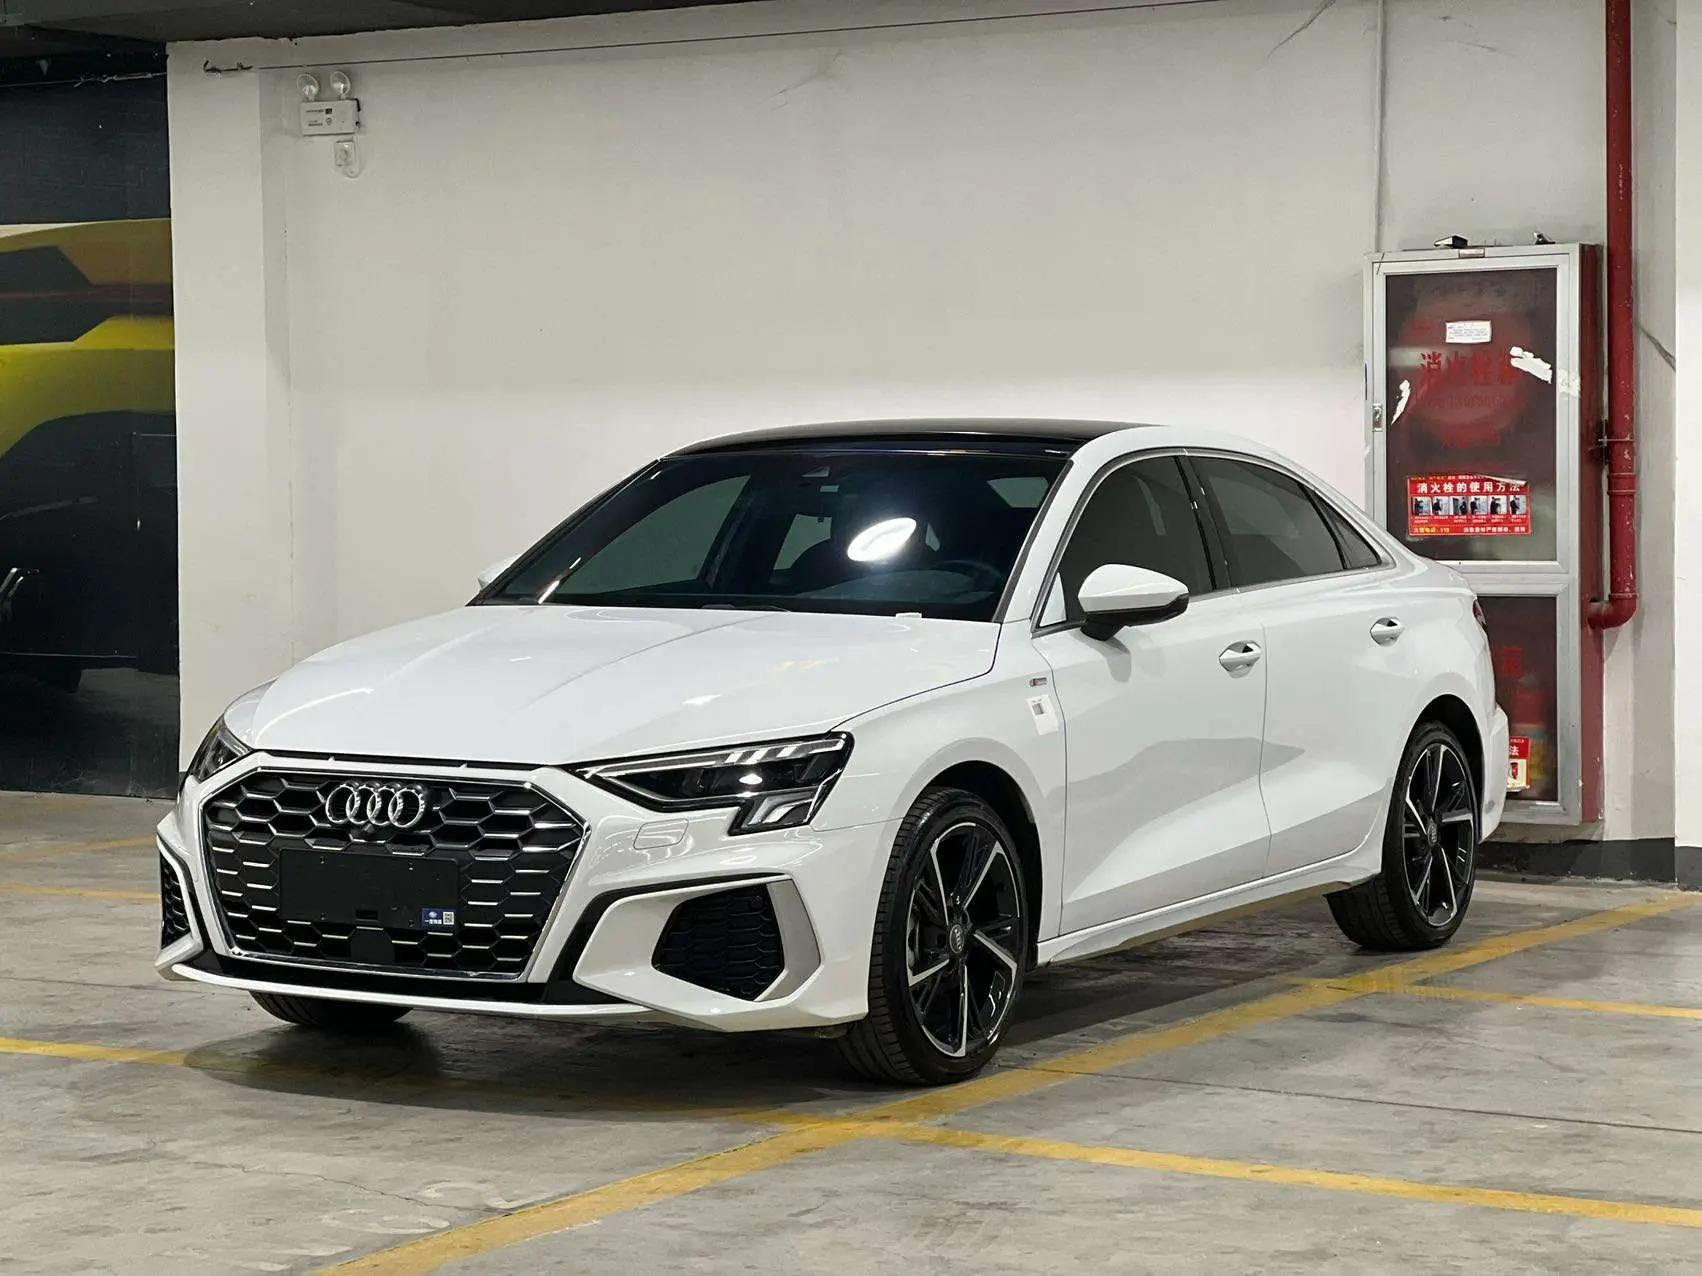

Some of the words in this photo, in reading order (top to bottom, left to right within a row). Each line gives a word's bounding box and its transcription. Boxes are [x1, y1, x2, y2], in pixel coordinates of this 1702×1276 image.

[1417, 481, 1520, 493] 消火栓的使用方法
